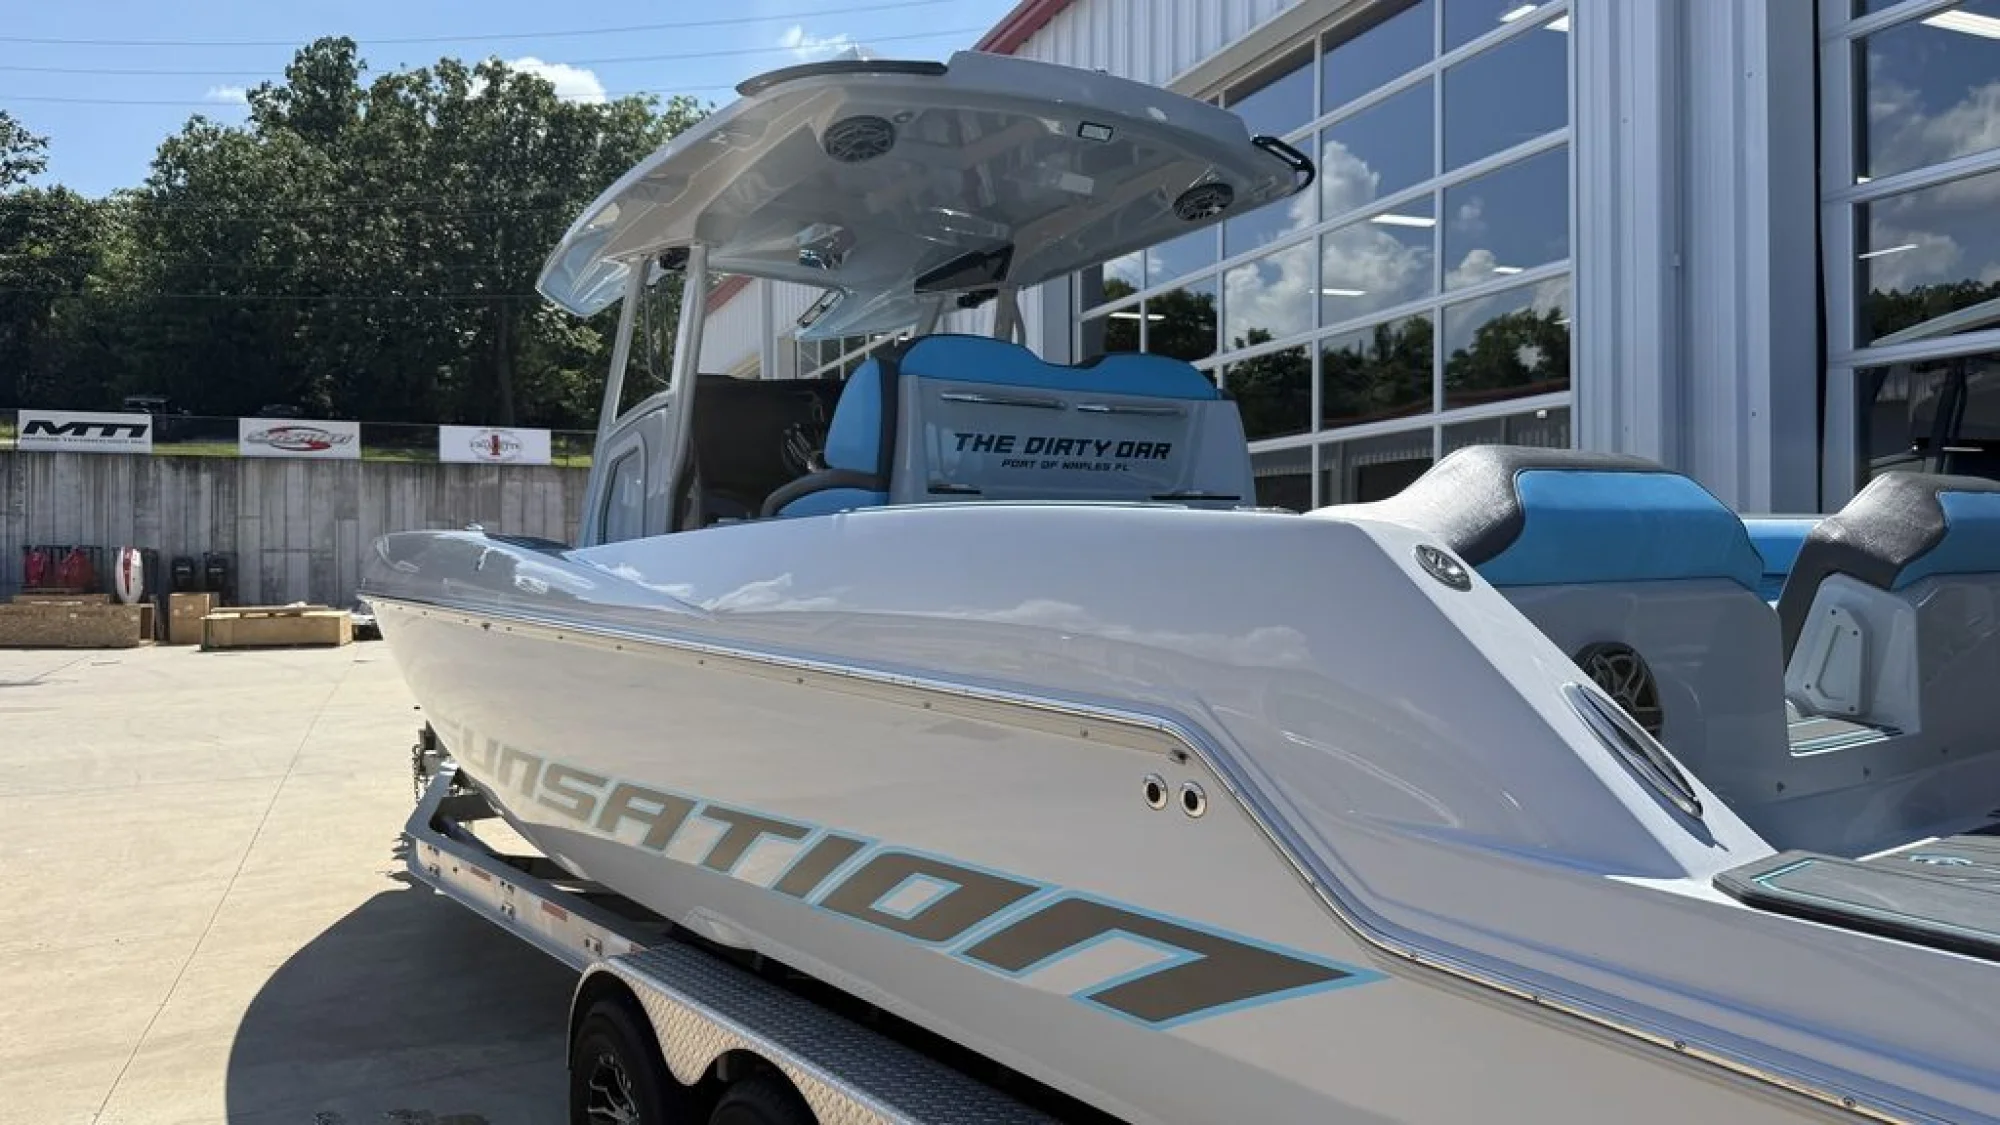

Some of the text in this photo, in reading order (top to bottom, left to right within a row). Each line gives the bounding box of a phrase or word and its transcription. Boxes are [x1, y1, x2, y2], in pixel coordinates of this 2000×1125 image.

[954, 432, 1173, 460] THE DIRTY OAR
[1001, 458, 1036, 470] PORT
[1040, 460, 1058, 470] OF
[1061, 460, 1111, 472] NAPLES
